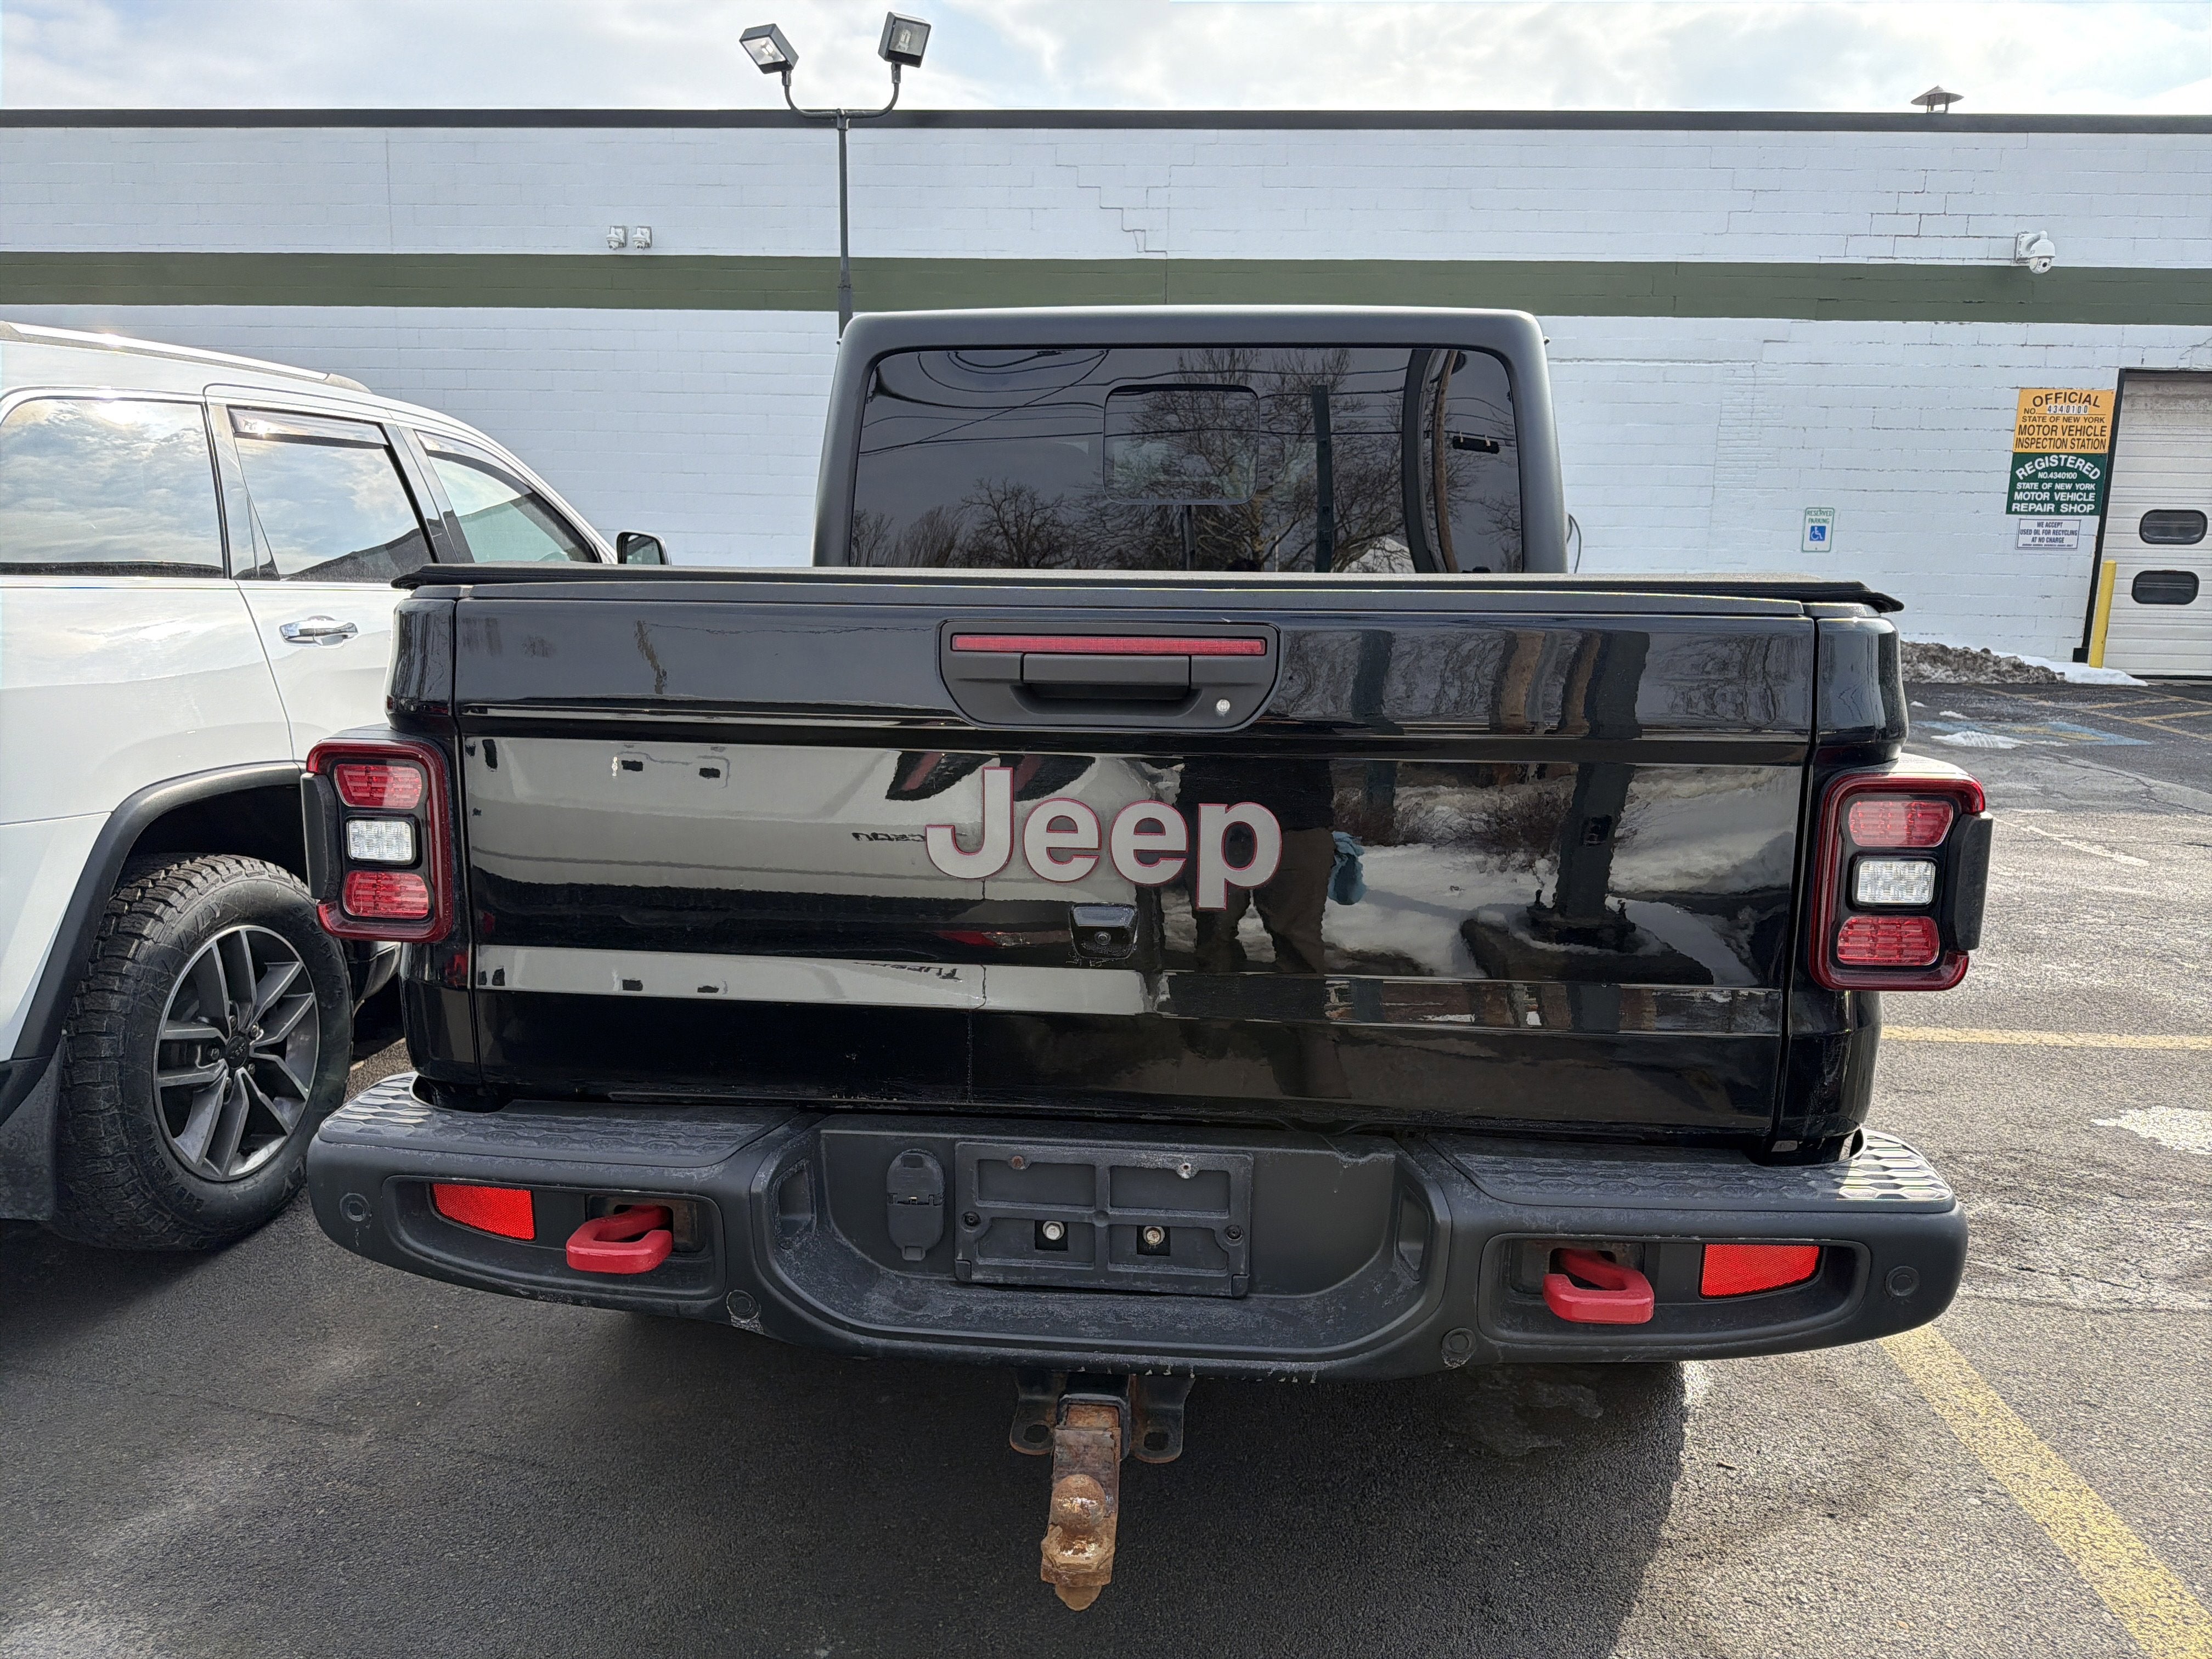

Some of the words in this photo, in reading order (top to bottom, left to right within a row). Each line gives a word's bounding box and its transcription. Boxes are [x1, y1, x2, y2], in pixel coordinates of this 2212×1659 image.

[2032, 392, 2101, 408] OFFICIAL
[2047, 405, 2088, 414] 4340100
[2018, 424, 2058, 436] MOTOR
[2061, 425, 2107, 437] VEHICLE
[2015, 437, 2068, 449] INSPECTION
[2070, 438, 2106, 450] STATION
[2015, 454, 2101, 480] REGISTERED
[2014, 492, 2050, 500] MOTOR
[2054, 493, 2096, 501] VEHICLE
[2011, 503, 2055, 512] REPAIR
[2059, 504, 2095, 513] SHOP
[924, 766, 1283, 910] Jeep
